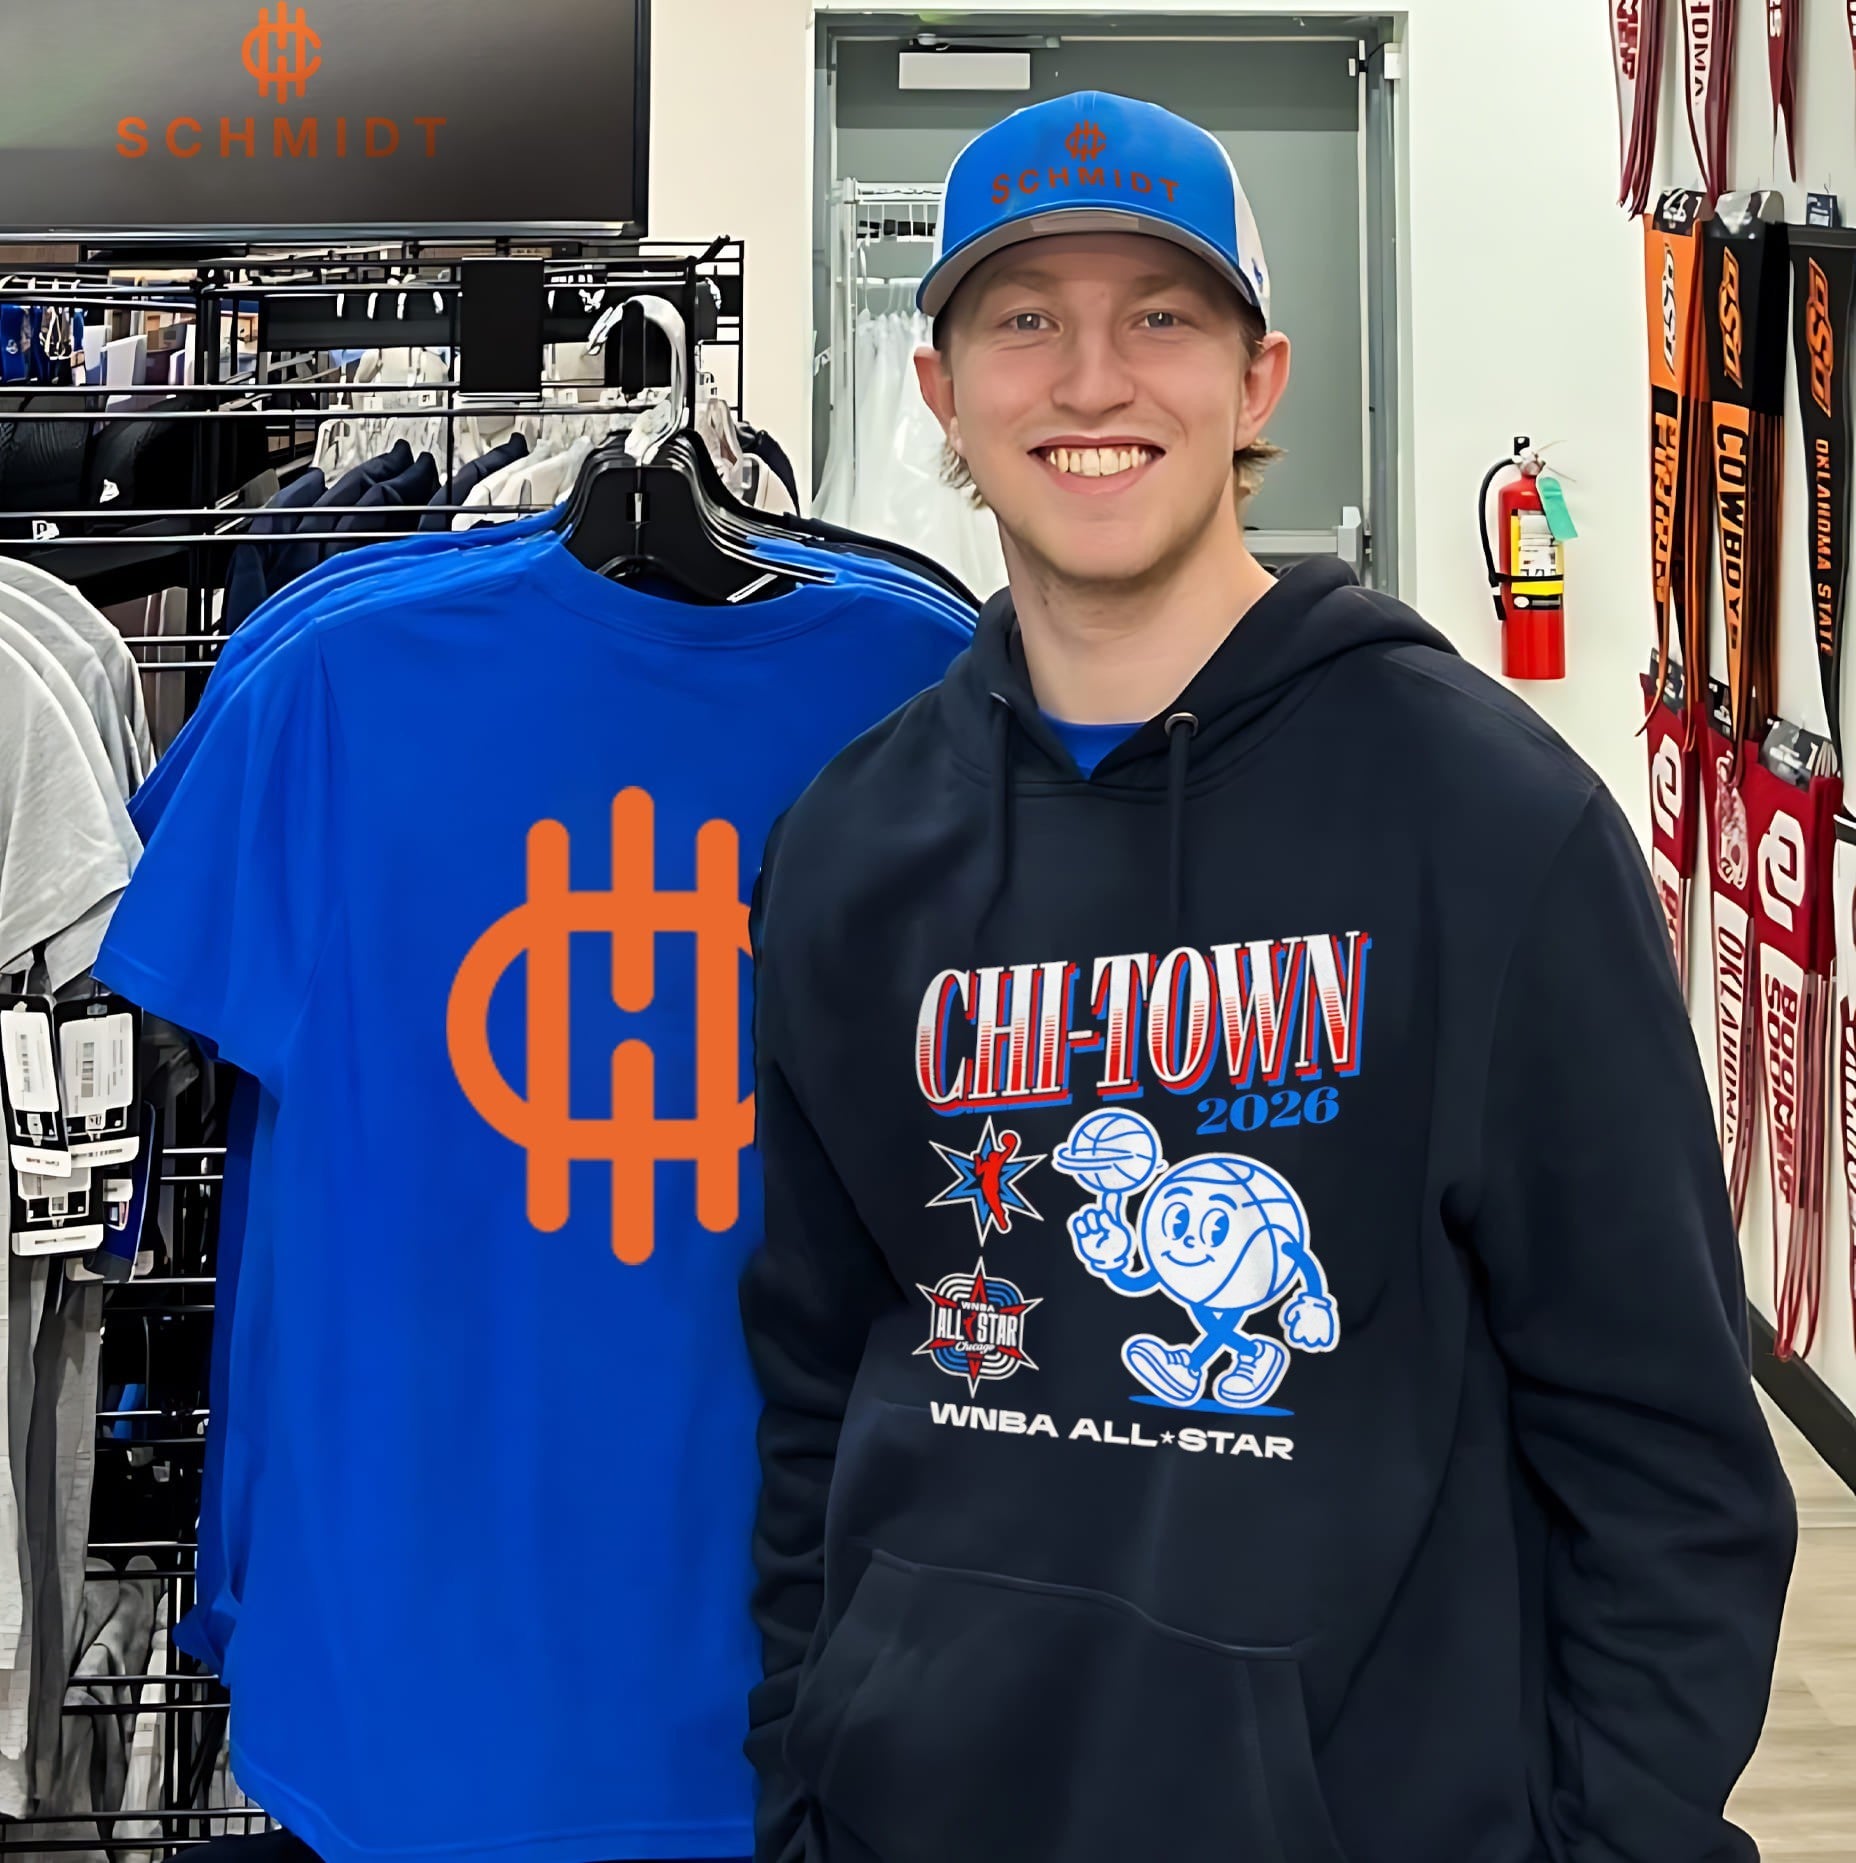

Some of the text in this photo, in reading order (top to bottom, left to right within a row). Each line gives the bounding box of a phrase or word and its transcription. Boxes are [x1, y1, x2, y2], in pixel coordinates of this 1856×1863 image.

[116, 116, 447, 158] SCHMIDT
[992, 167, 1179, 205] SCHMIDT
[1815, 439, 1833, 657] OKLAHOMA STATE
[915, 930, 1372, 1117] CHI-TOWN
[1196, 1086, 1340, 1135] 2026
[936, 1307, 1018, 1347] ALL STAR
[961, 1301, 995, 1313] WNBA
[955, 1341, 996, 1354] Chicago
[930, 1401, 1059, 1438] WNBA
